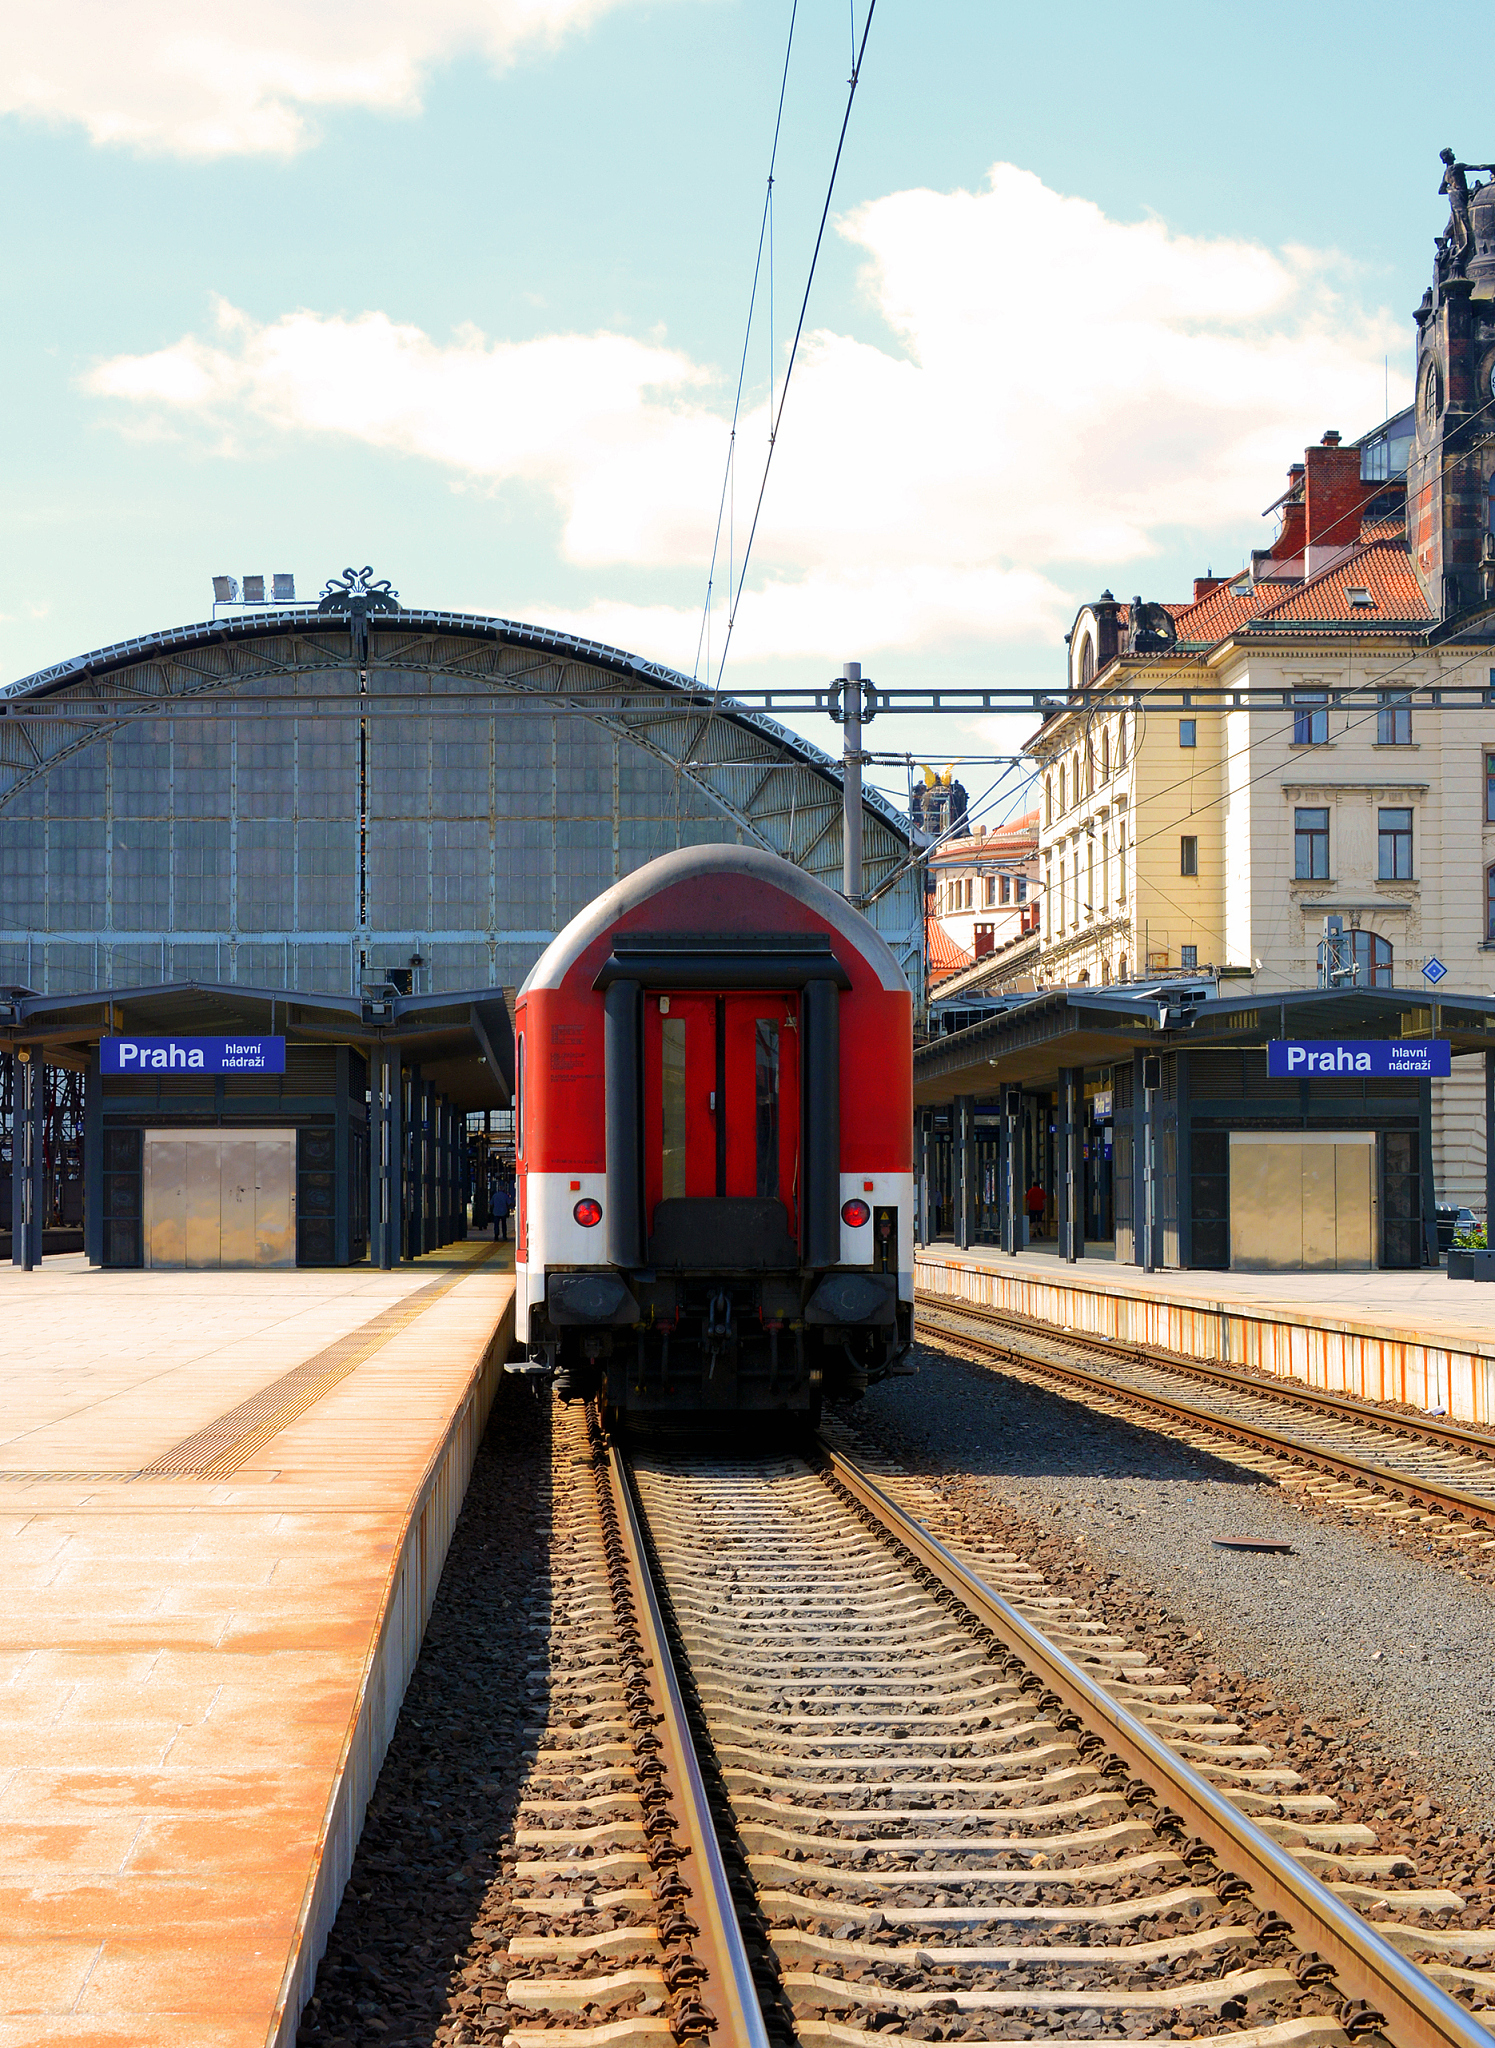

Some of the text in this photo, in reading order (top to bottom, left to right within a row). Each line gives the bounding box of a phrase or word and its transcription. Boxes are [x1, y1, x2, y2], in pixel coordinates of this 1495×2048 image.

[225, 1043, 261, 1054] hlavní
[1392, 1047, 1428, 1057] hlavní
[119, 1043, 204, 1068] Praha
[1287, 1047, 1371, 1071] Praha
[221, 1056, 265, 1067] nádraží
[1388, 1060, 1432, 1070] nádraží
